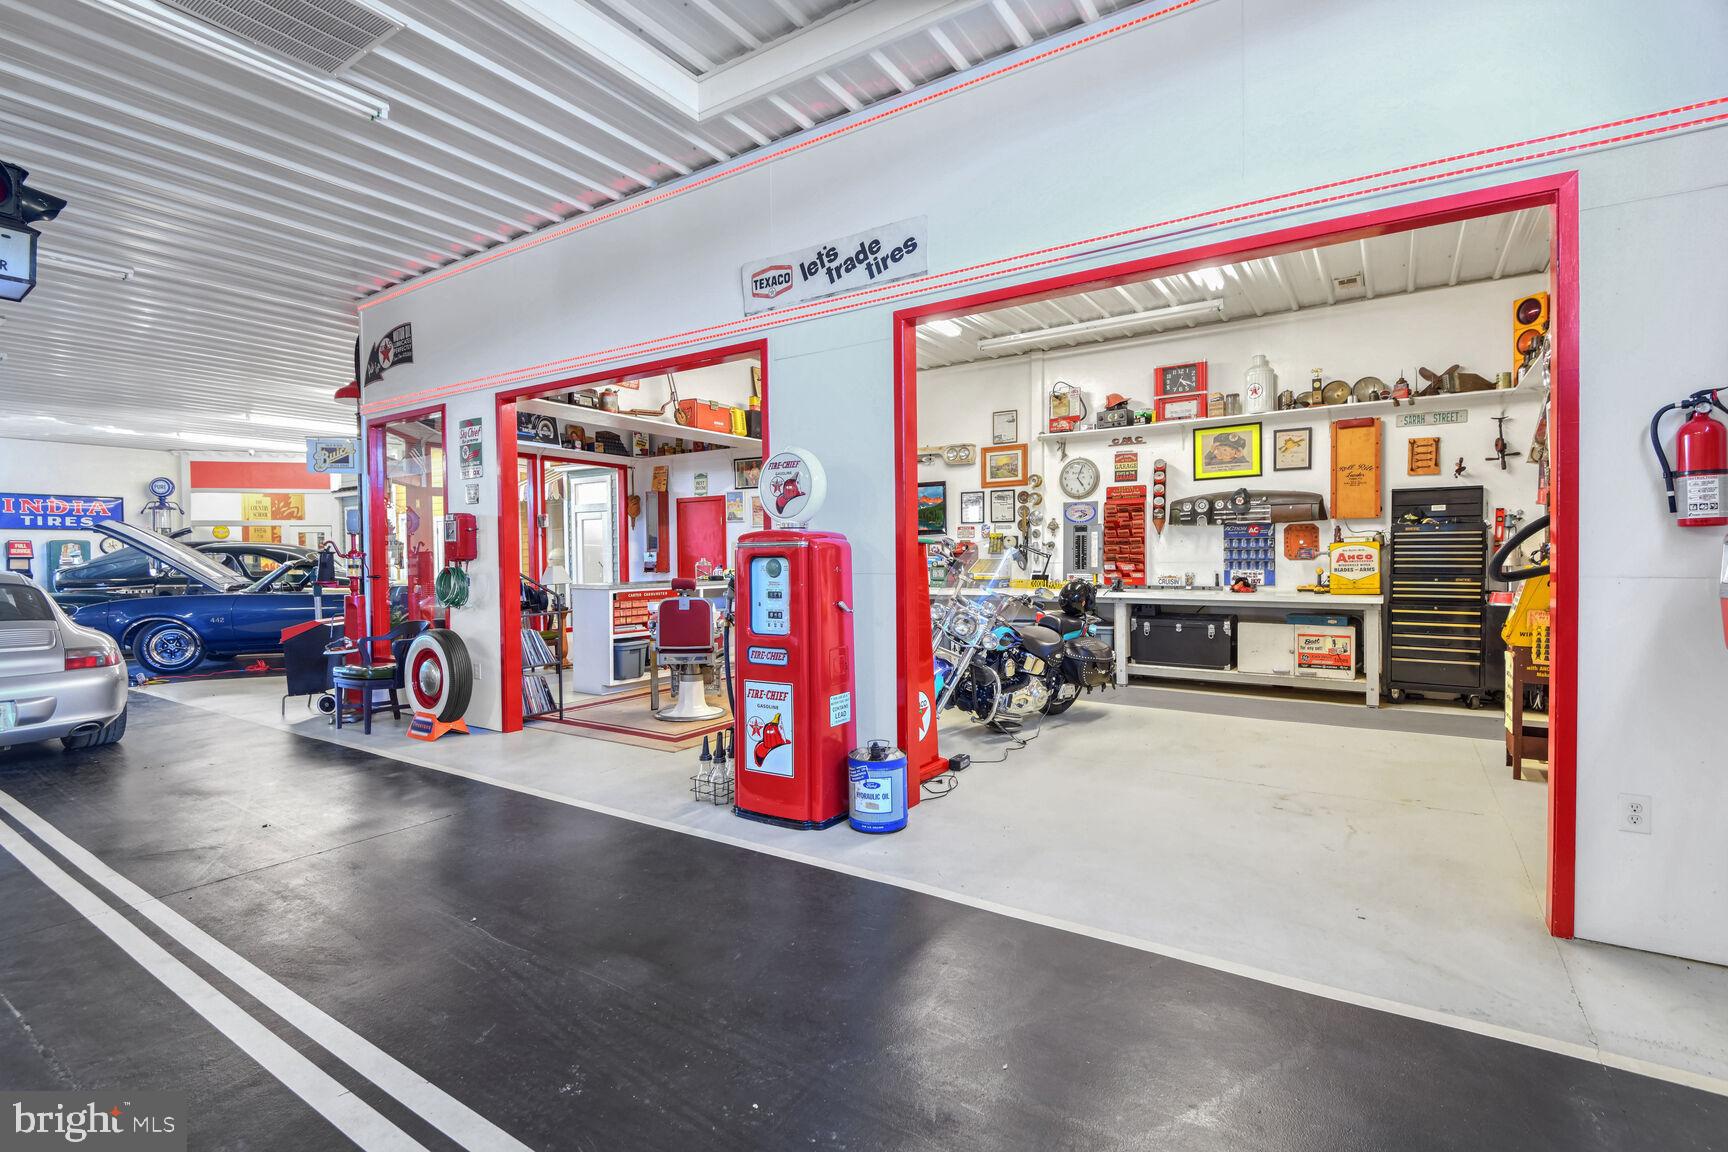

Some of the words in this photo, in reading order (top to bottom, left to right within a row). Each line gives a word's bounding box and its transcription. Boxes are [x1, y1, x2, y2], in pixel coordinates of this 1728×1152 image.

[799, 246, 839, 282] let's
[825, 239, 882, 285] trade
[865, 236, 918, 280] tires
[753, 272, 791, 291] TEXACO
[1403, 414, 1425, 425] SARAH
[1433, 412, 1459, 423] STREET
[467, 427, 481, 437] Chief
[768, 460, 801, 470] FIRE-CHIEF
[1115, 462, 1138, 470] GARAGE
[2, 498, 111, 516] INDIA
[20, 515, 94, 527] TIRES
[750, 650, 787, 661] FIRE-CHIEF
[747, 689, 789, 701] FIRE-CHIEF
[835, 710, 847, 719] LEAD
